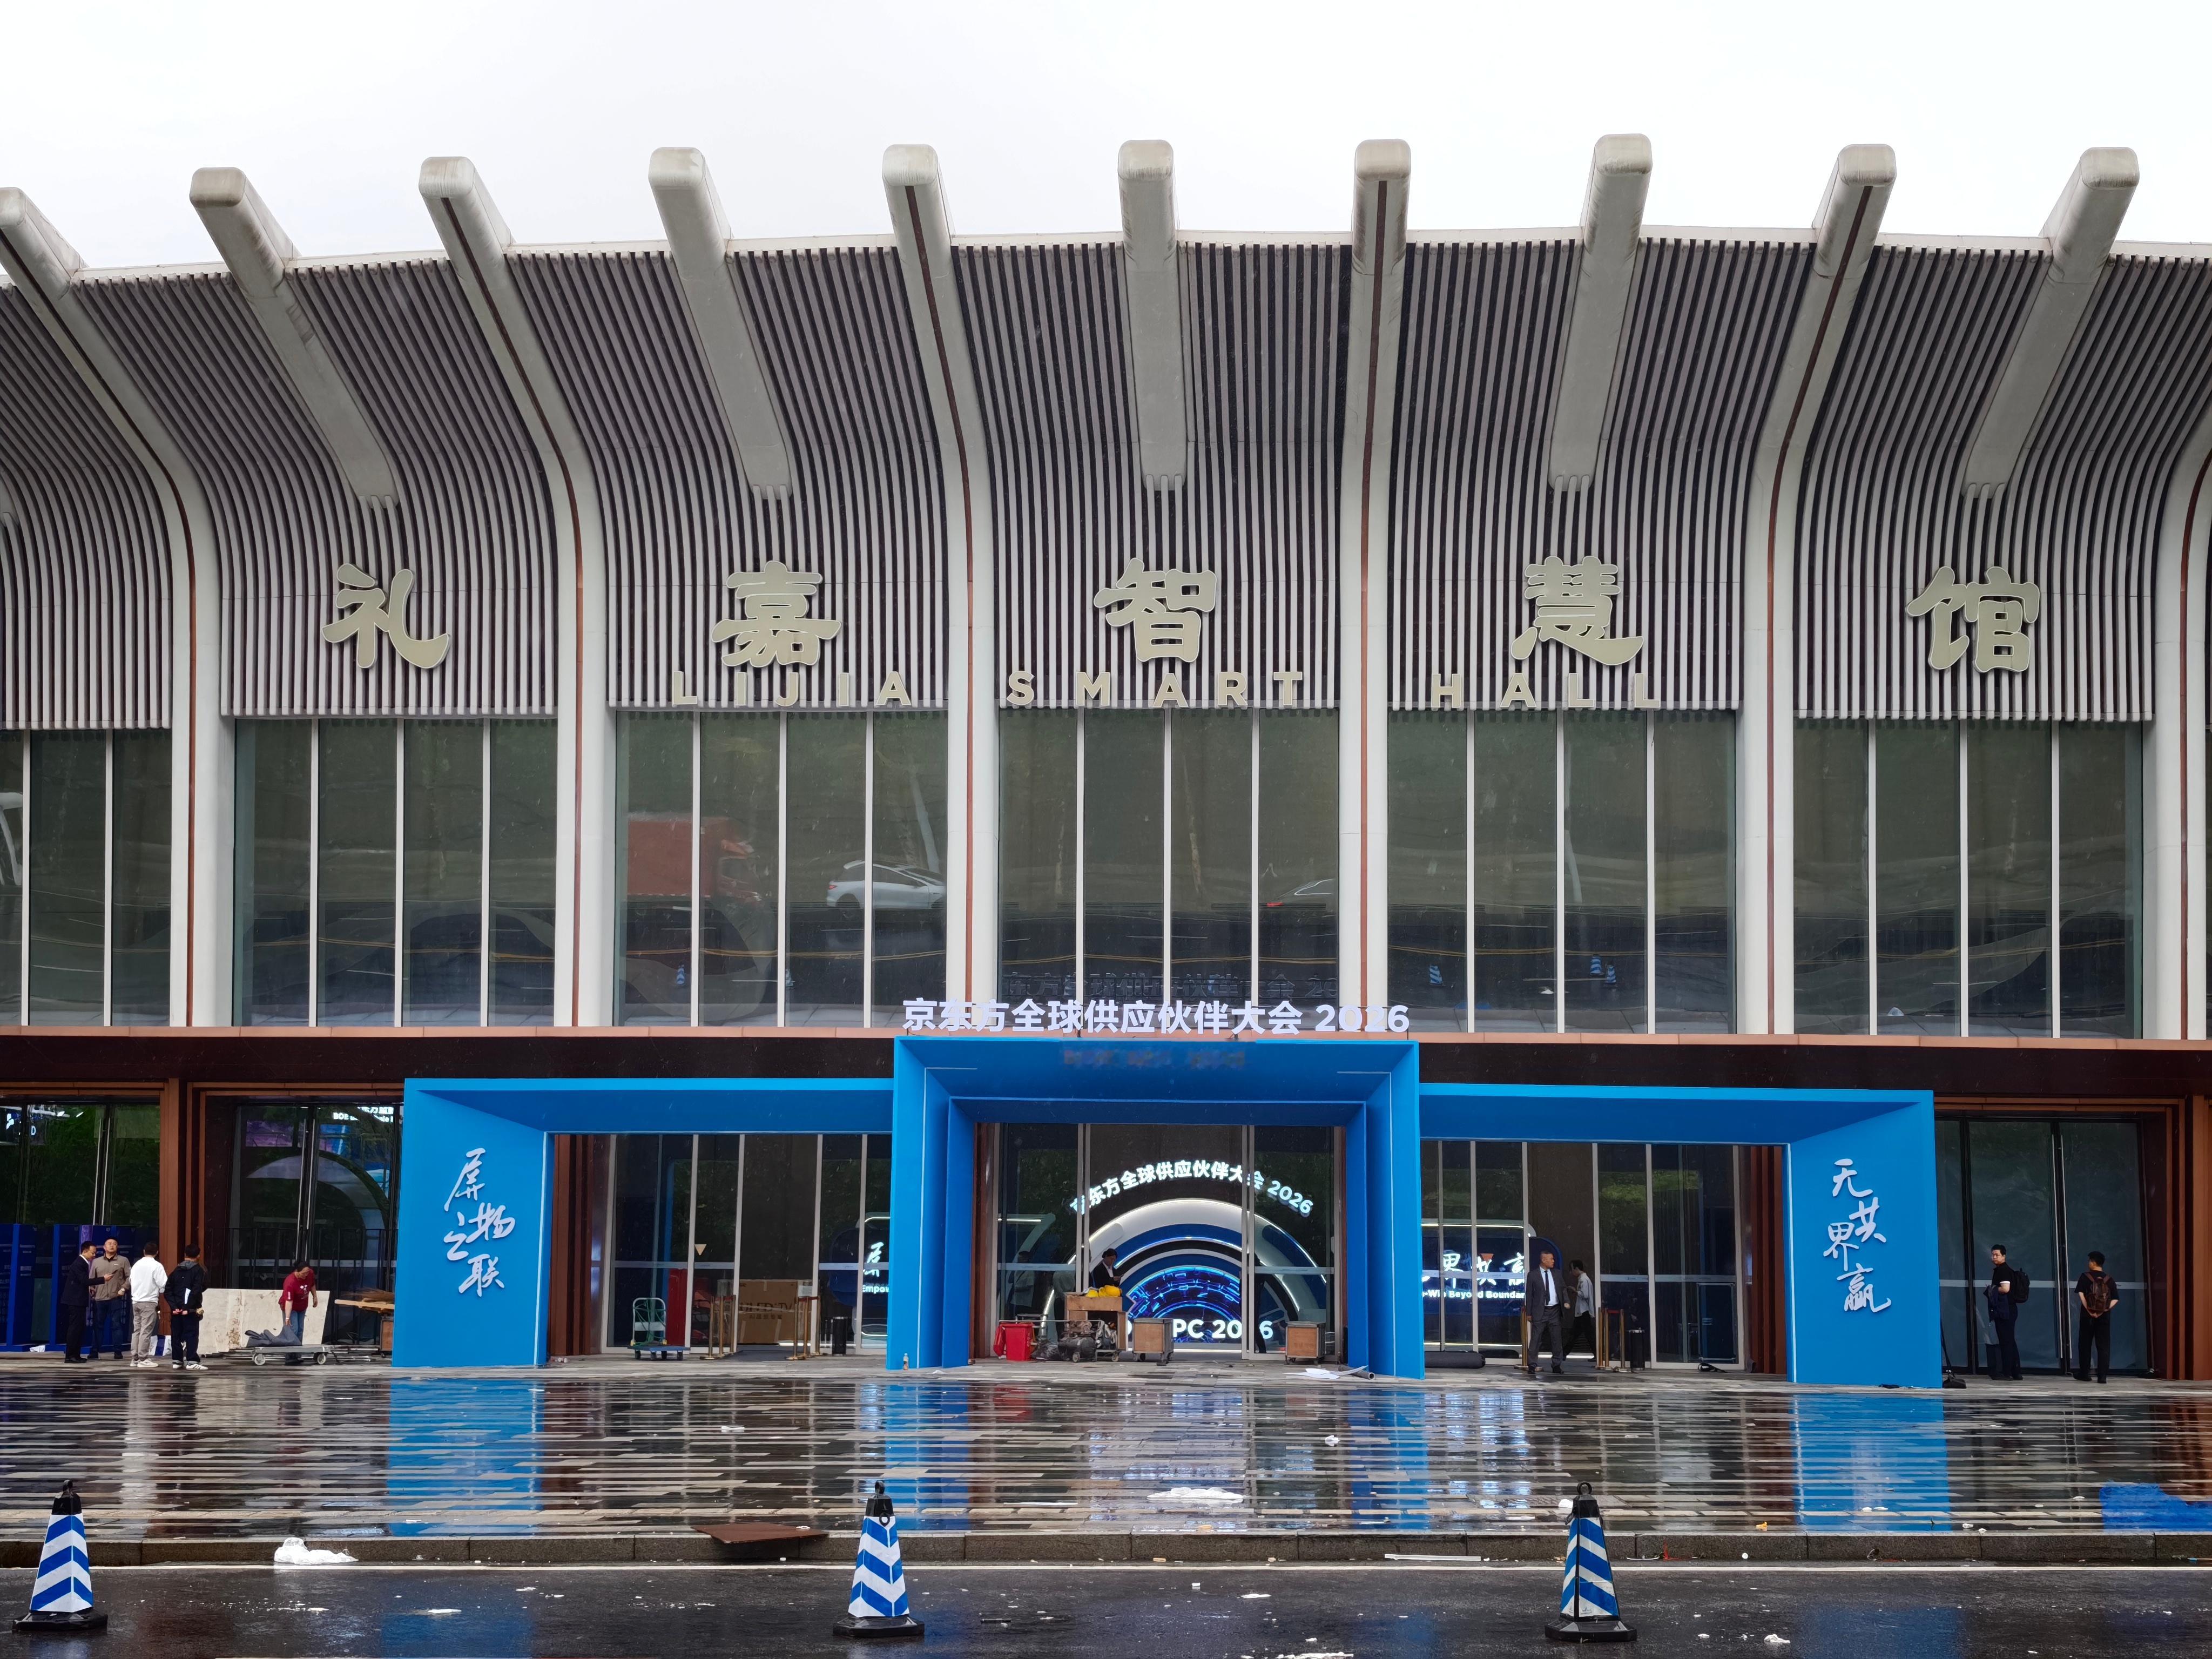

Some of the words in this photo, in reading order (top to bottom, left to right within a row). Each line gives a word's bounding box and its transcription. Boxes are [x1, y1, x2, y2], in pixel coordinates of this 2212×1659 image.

[673, 671, 912, 707] LIJIA
[1006, 670, 1303, 708] SMART
[1431, 672, 1661, 709] HALL
[902, 997, 1303, 1035] 京东方全球供应伙伴大会
[1314, 1003, 1410, 1033] 2026
[1267, 1180, 1314, 1214] 2026
[1449, 1290, 1483, 1299] Beyod
[1486, 1290, 1525, 1299] Boundar
[1212, 1319, 1273, 1340] 206
